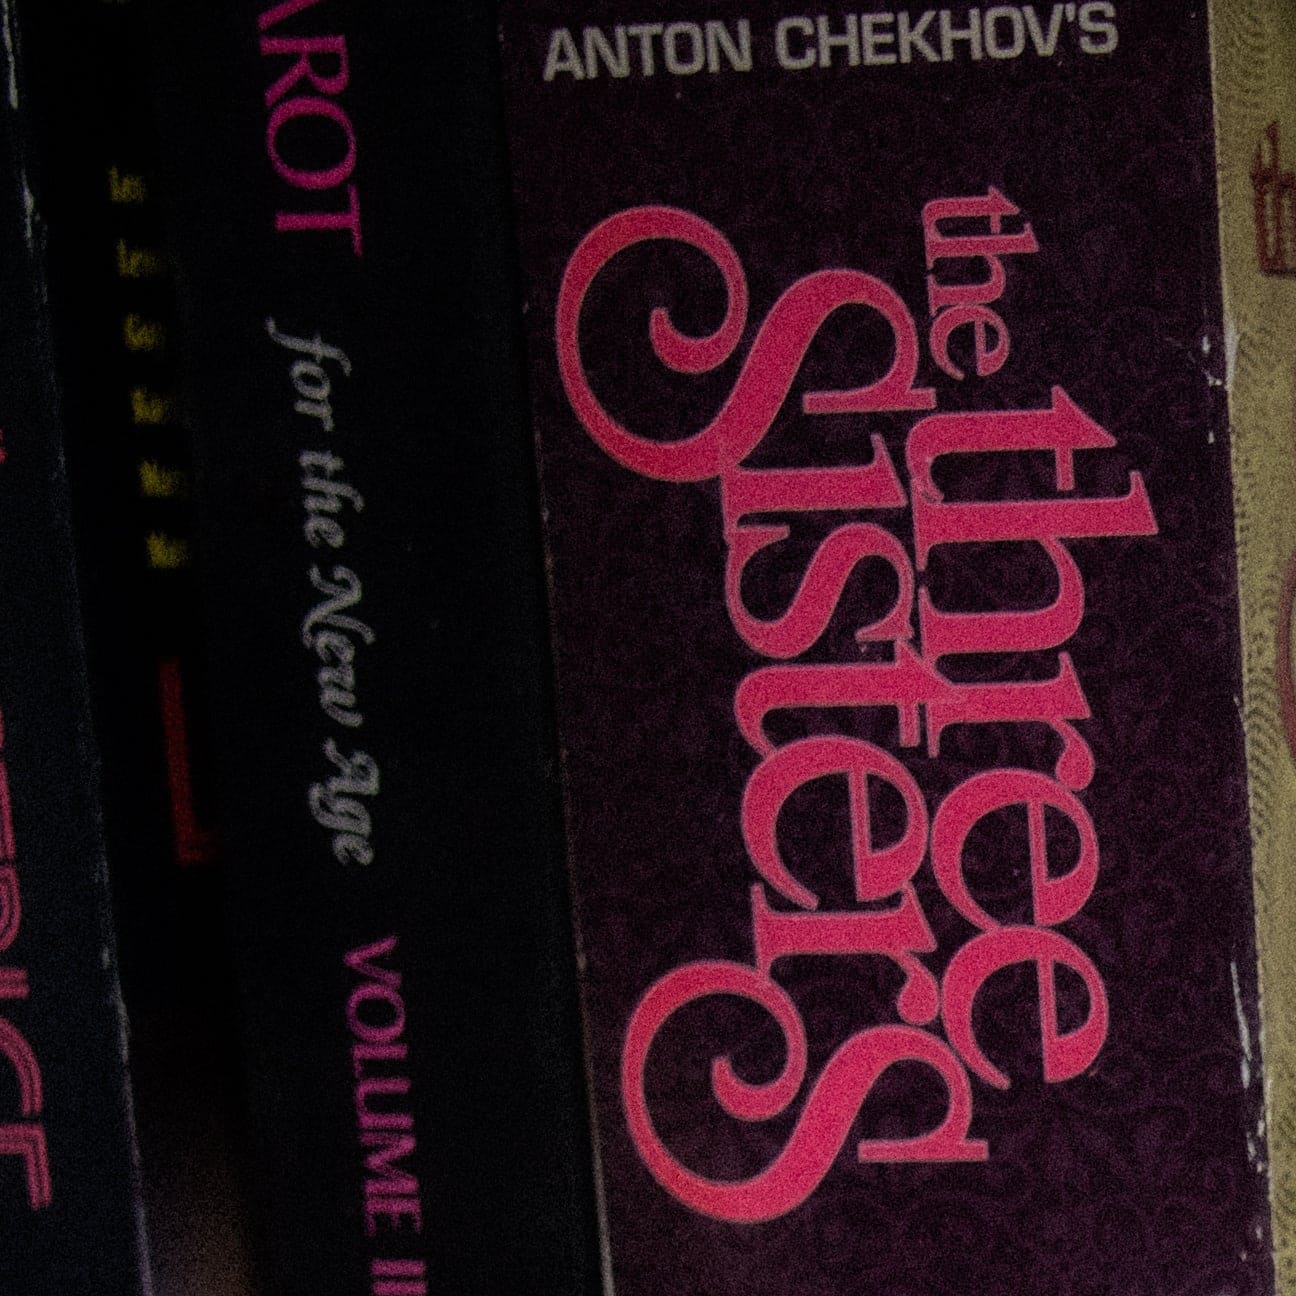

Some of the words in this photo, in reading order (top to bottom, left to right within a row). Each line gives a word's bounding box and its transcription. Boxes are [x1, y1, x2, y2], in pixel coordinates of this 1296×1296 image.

[542, 16, 754, 84] ANTON
[775, 1, 1122, 72] CHEKHOV'S
[921, 184, 1041, 381] the
[263, 314, 352, 433] for
[298, 448, 366, 549] the
[301, 563, 377, 728] New
[554, 204, 990, 1226] Sisters
[307, 736, 381, 868] Age
[903, 384, 1161, 1092] three
[343, 934, 424, 1238] VOLUME
